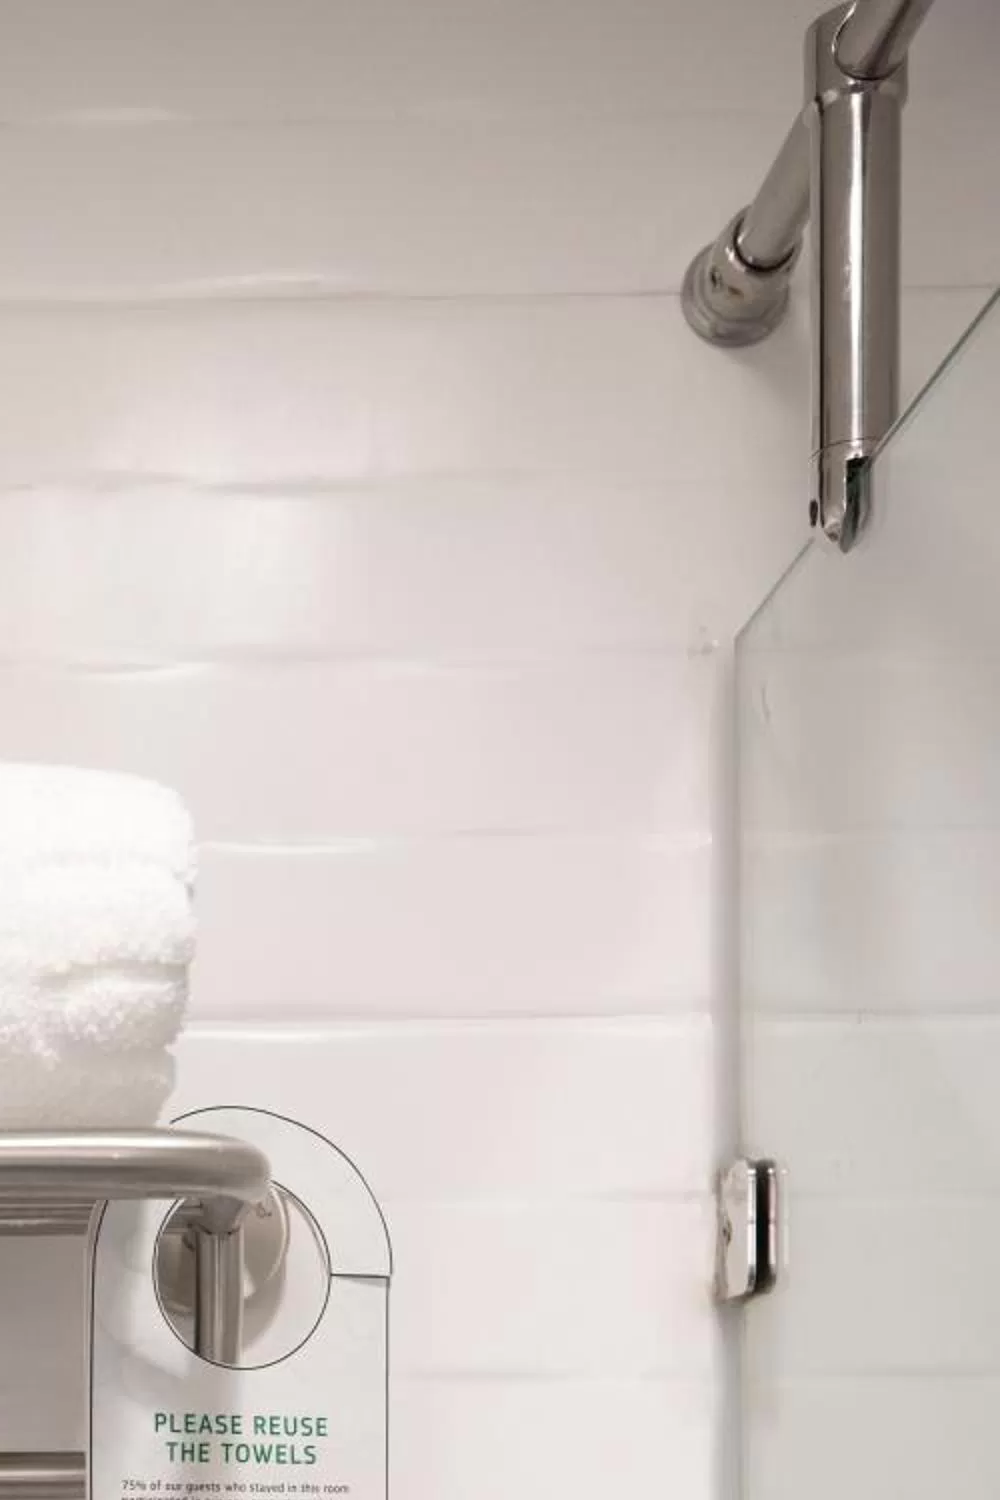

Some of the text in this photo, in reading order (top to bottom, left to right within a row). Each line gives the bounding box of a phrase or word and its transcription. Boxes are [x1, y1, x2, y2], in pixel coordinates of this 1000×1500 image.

[155, 1413, 328, 1436] PLEASE REUSE
[166, 1442, 317, 1464] THE TOWELS
[122, 1480, 349, 1493] 75% of our guests who stayed in this room
